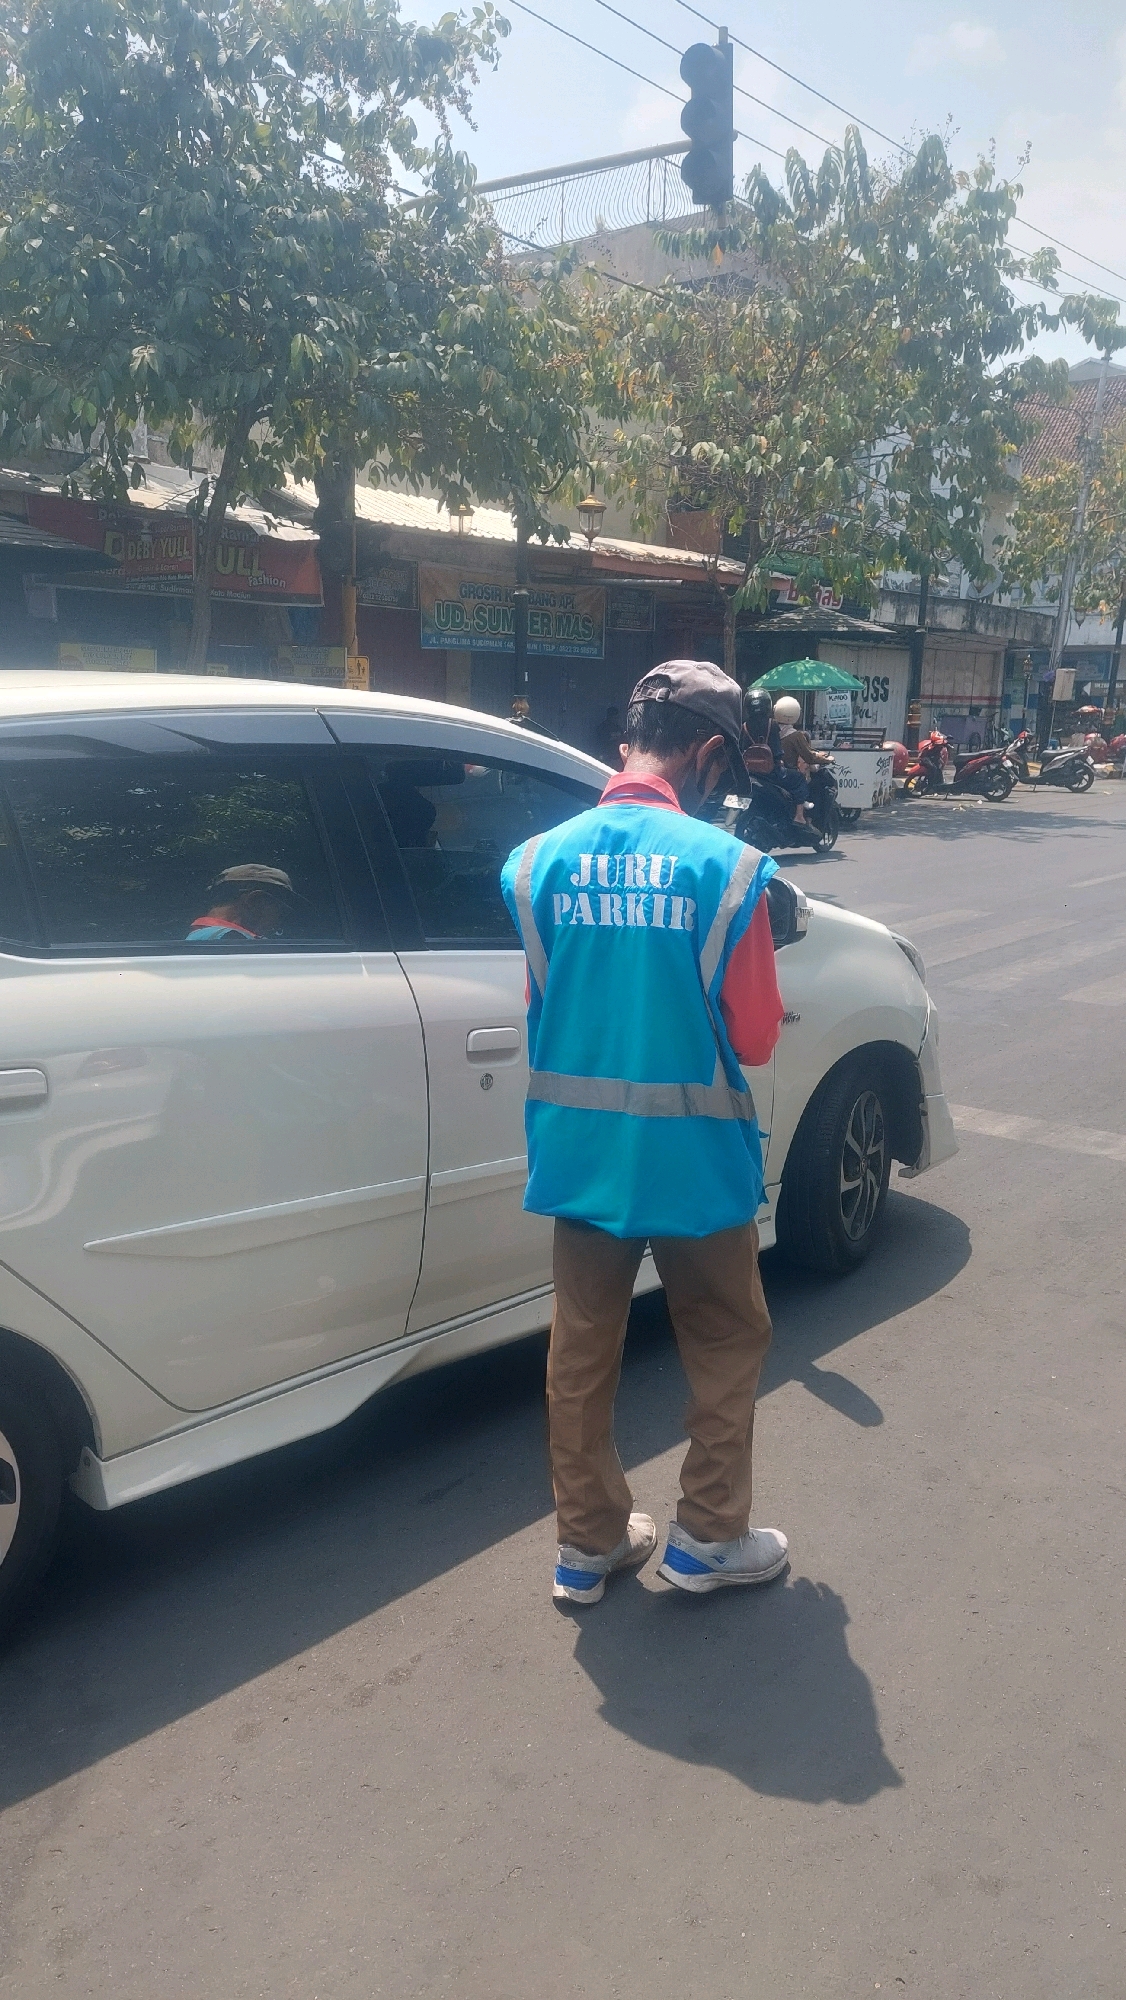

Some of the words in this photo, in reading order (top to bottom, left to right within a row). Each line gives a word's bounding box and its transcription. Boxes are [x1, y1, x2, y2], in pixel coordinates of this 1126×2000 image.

[127, 541, 158, 560] DEBY
[160, 536, 190, 559] YULL
[460, 582, 502, 602] GROSIR
[504, 586, 557, 609] KBANG
[434, 599, 471, 632] UD.
[473, 603, 554, 639] SUMER
[555, 611, 594, 641] MAS
[569, 853, 679, 888] JURU
[552, 892, 697, 932] PARKIR
